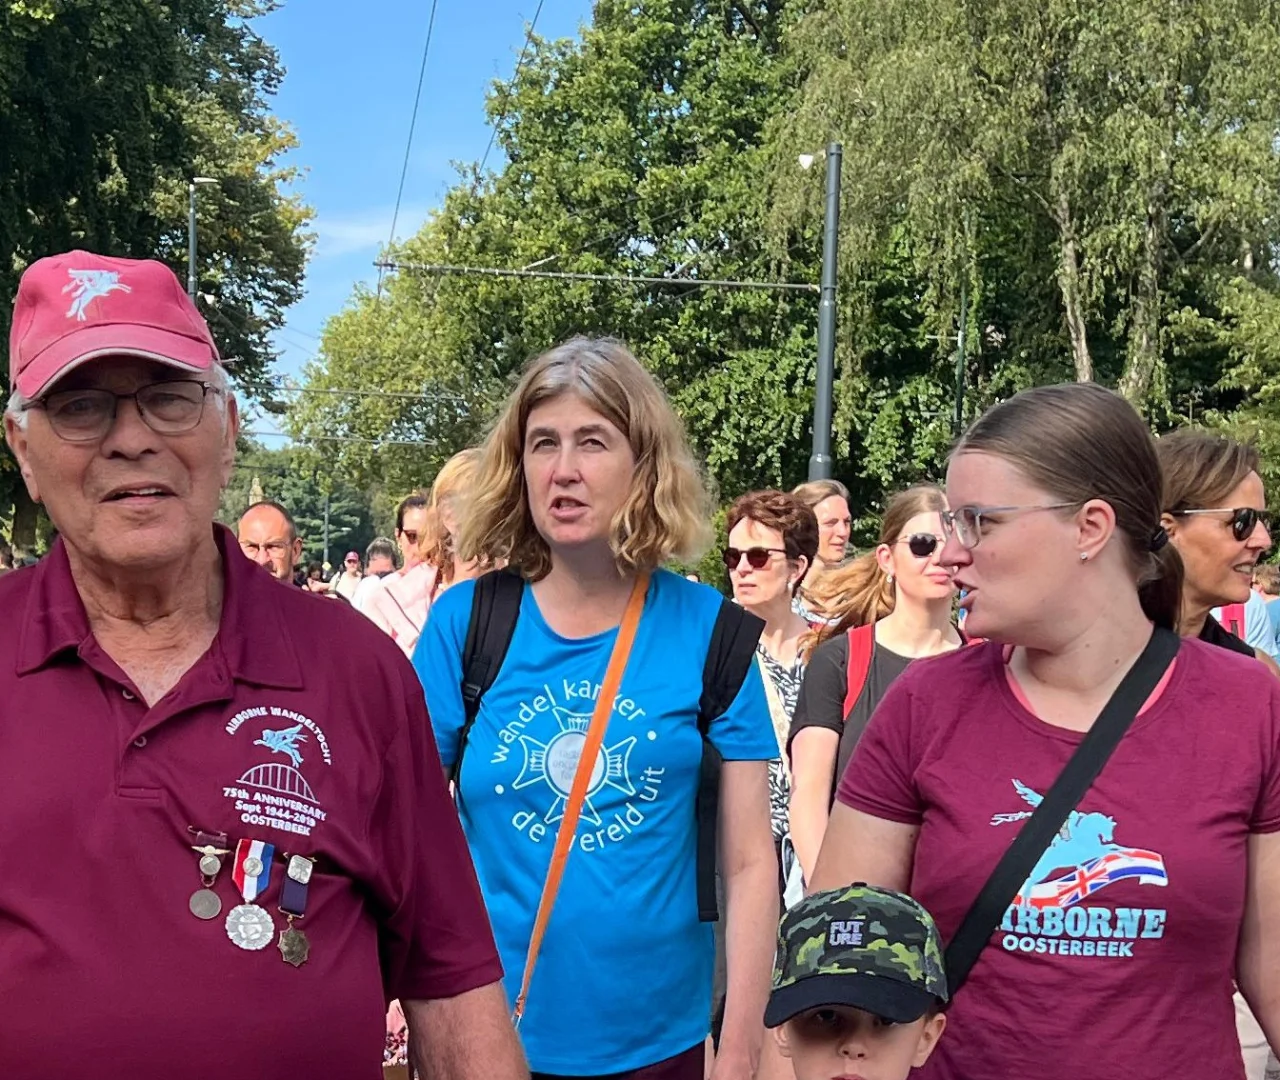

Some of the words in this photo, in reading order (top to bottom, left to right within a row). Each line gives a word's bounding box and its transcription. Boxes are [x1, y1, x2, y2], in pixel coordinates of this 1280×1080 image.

[225, 706, 268, 735] AIRBORNE
[270, 706, 331, 765] WANDELTOCHT
[491, 684, 556, 764] wandel
[223, 787, 249, 800] 75th
[253, 792, 327, 821] ANNIVERSARY
[235, 800, 261, 813] Sept
[512, 811, 545, 842] de
[639, 766, 665, 801] uit
[241, 813, 311, 836] OOSTERBEEK
[830, 921, 864, 933] FUT
[998, 905, 1167, 939] IRBORNE
[829, 933, 862, 946] URE
[1002, 935, 1133, 957] OOSTERBEEK
